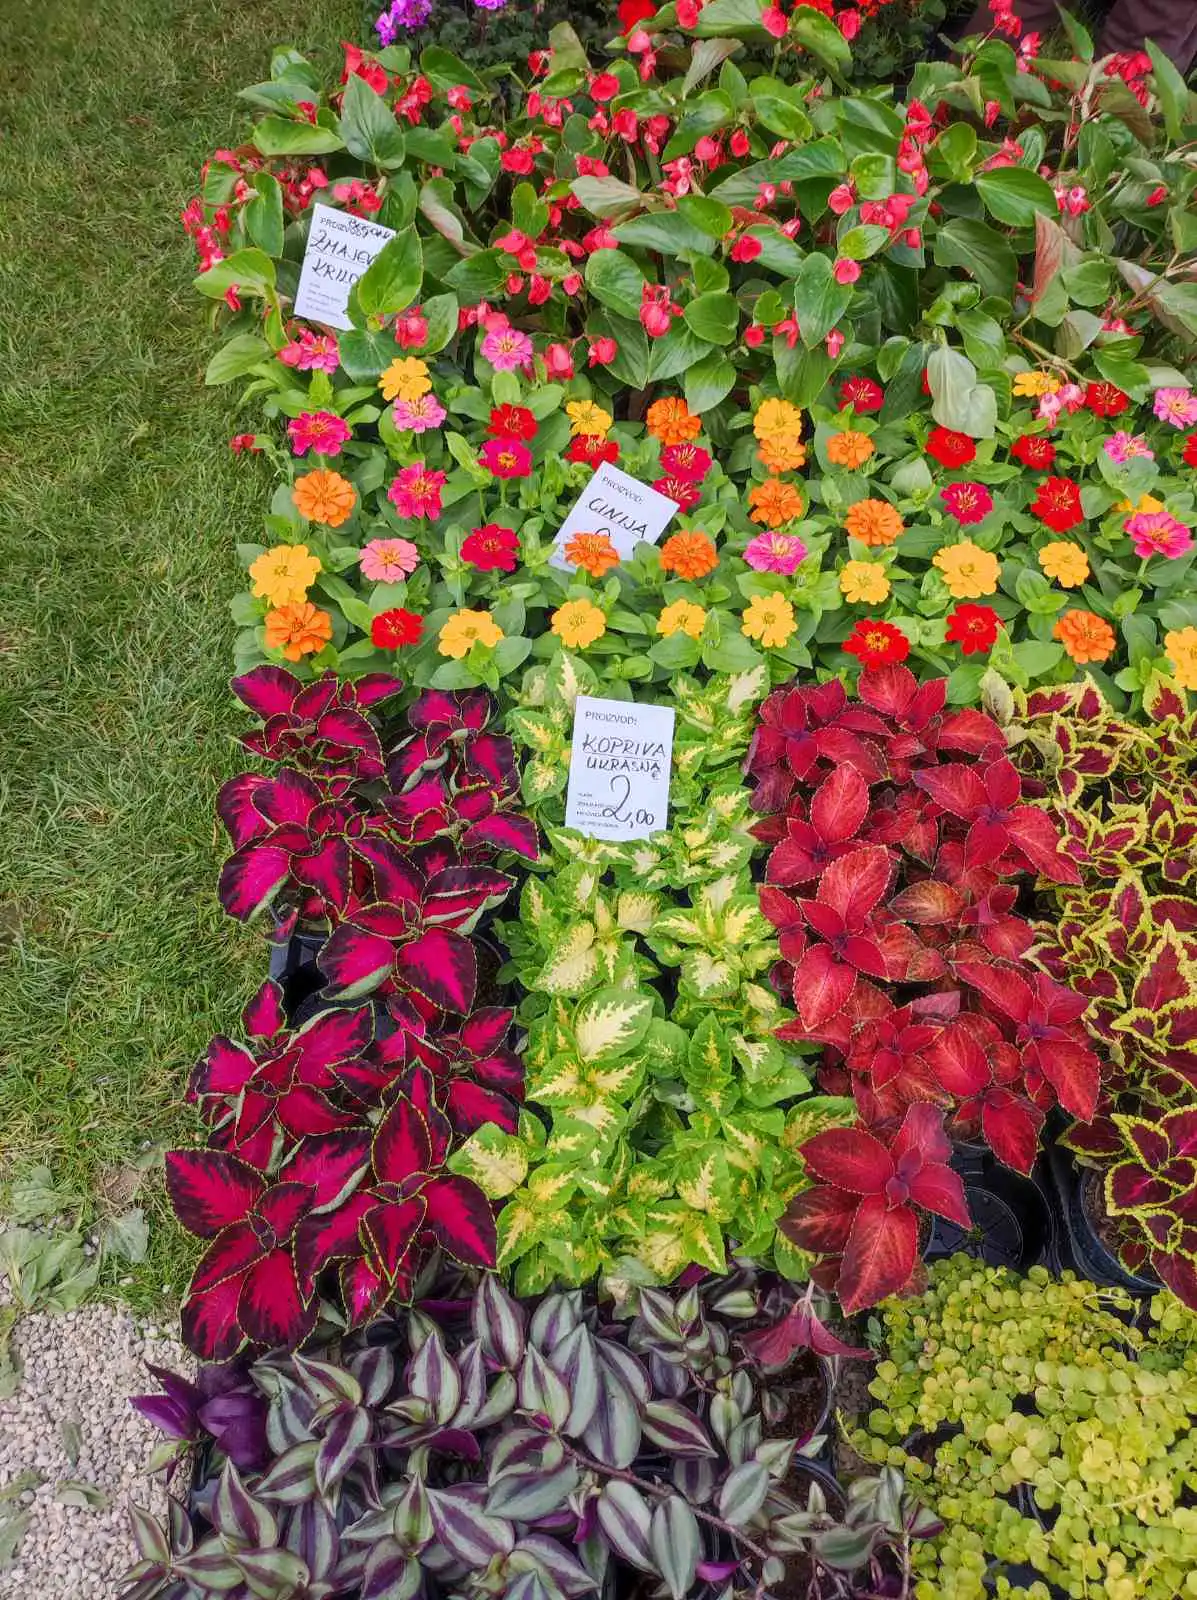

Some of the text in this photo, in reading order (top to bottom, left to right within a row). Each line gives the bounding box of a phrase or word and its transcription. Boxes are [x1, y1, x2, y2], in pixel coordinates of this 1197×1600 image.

[588, 497, 648, 539] CINIJA
[585, 711, 637, 725] PROIZVOD:
[582, 733, 665, 757] KOPRIVA
[602, 774, 655, 829] 2,00
